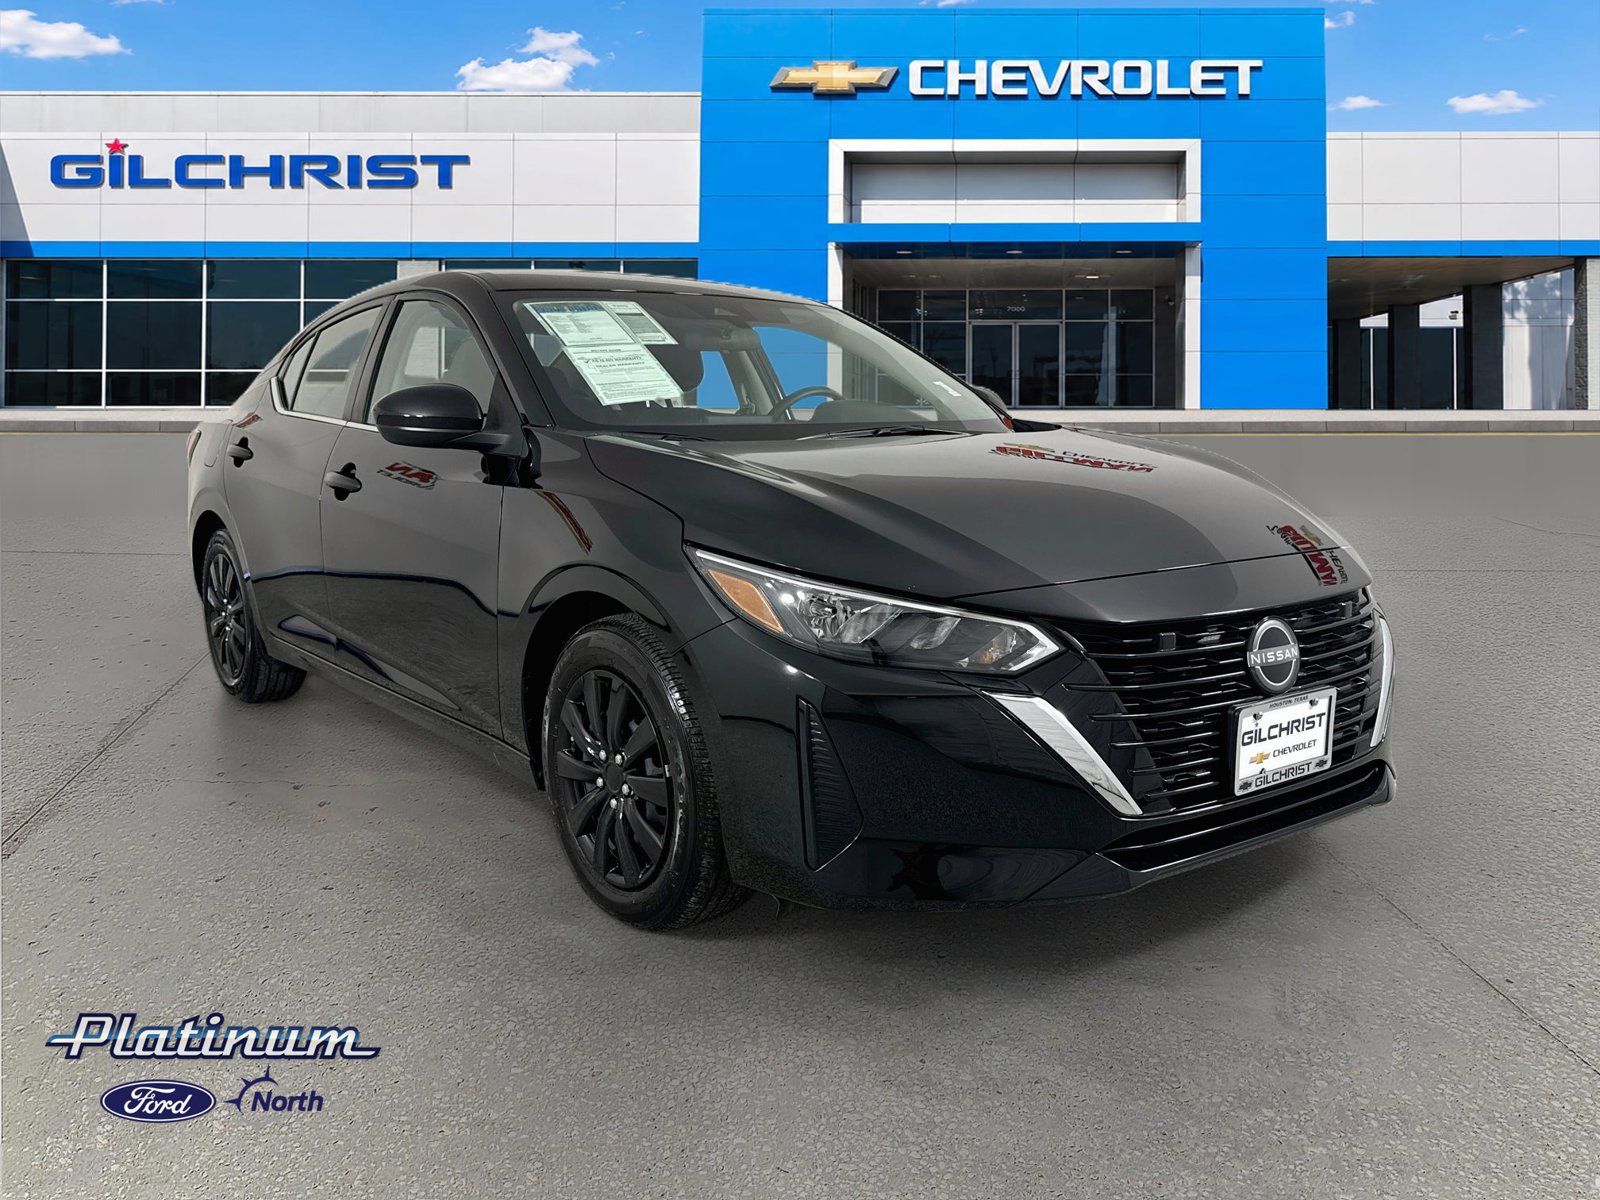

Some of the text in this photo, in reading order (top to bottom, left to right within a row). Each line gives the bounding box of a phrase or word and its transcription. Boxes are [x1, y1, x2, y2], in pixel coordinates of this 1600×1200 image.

[907, 59, 1264, 99] CHEVROLET
[50, 150, 470, 189] GILCHRIST
[1006, 305, 1026, 313] 7000
[1249, 646, 1299, 666] NISSAN
[1293, 695, 1309, 703] TEXAS
[1241, 712, 1326, 747] GILCHRIST
[1272, 739, 1318, 758] CHEVROLET
[1254, 762, 1313, 788] GILCHRIST
